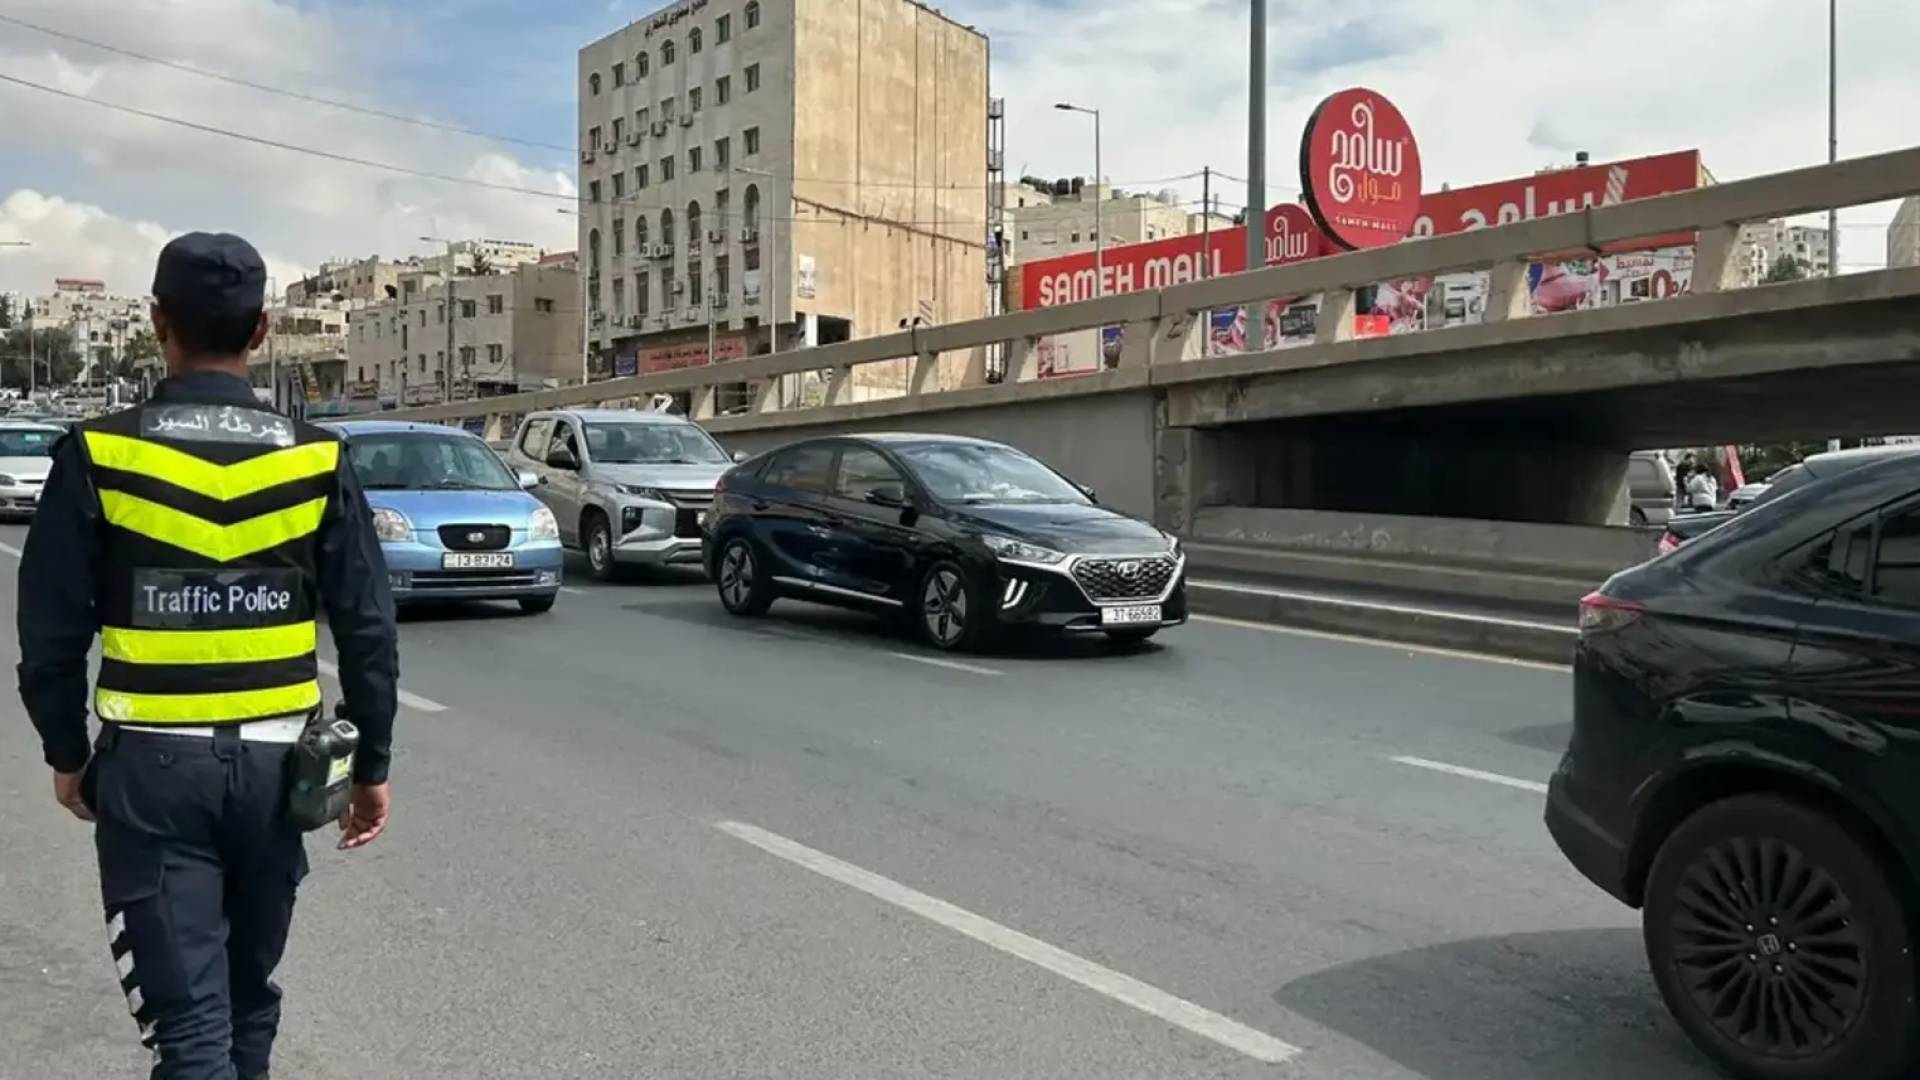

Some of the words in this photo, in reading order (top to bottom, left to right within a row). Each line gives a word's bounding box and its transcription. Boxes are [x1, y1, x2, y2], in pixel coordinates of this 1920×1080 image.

[1356, 175, 1402, 206] مول
[1039, 262, 1135, 307] SAMEH
[148, 412, 210, 433] السير
[218, 406, 288, 439] شرطة
[143, 585, 221, 614] Traffic
[228, 585, 291, 614] Police
